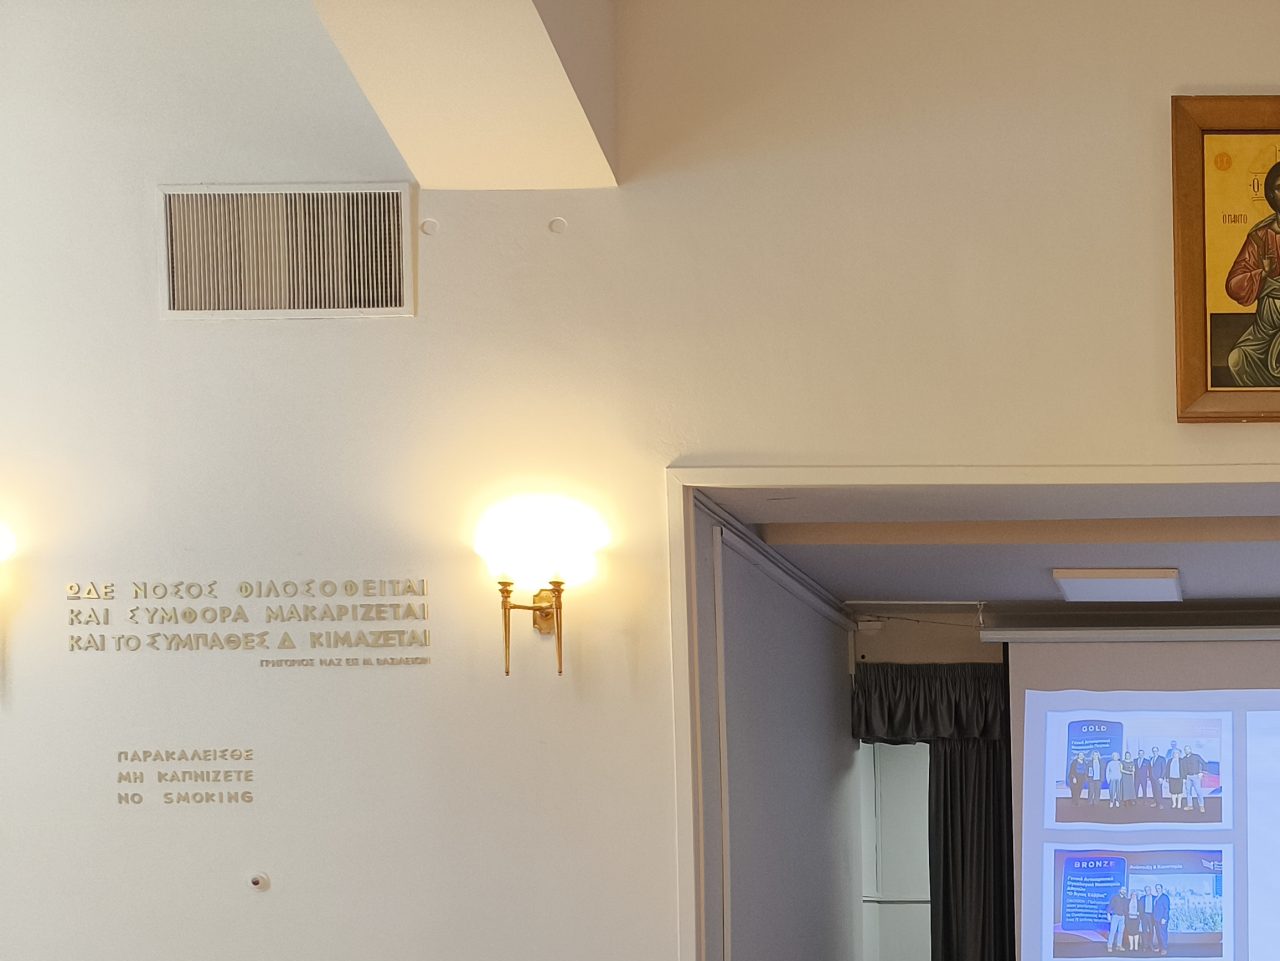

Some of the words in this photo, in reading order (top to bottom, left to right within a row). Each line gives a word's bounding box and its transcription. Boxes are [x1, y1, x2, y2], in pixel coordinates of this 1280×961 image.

[66, 581, 116, 600] ΩΔΕ
[132, 580, 218, 600] ΝΟΣΟΣ
[238, 578, 428, 599] ΦΙΛΟΣΟΦΕΙΤΑΙ
[68, 607, 110, 626] ΚΑΙ
[128, 604, 249, 625] ΣΥΜΦΟΡΑ
[265, 602, 429, 624] ΜΑΚΑΡΙΖΕΤΑΙ
[68, 633, 106, 651] ΚΑΙ
[112, 634, 142, 651] ΤΟ
[146, 630, 270, 651] ΣΥΜΠΑΘΕΣ
[1082, 725, 1107, 733] GOLD
[117, 748, 254, 763] ΠΑΡΑΚΑΛΕΙΣΘΕ
[117, 771, 144, 784] ΜΗ
[157, 769, 254, 783] ΚΑΠΝΙΖΕΤΕ
[117, 792, 144, 805] NO
[163, 790, 254, 804] SMOKING
